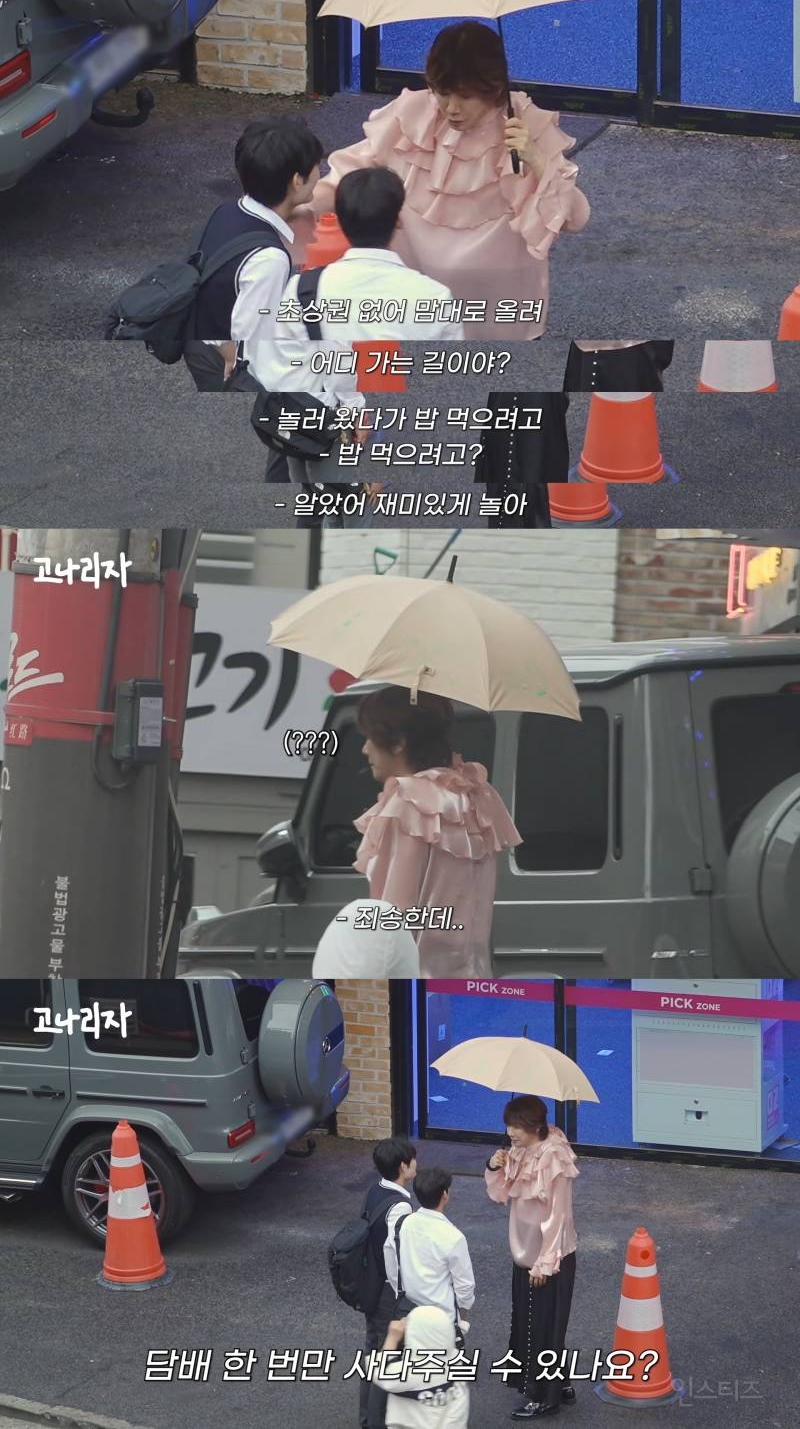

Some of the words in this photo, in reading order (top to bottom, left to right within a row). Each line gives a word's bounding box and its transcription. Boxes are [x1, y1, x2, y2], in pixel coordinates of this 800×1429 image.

[467, 980, 499, 994] PICK
[501, 987, 526, 996] ZONE
[660, 996, 693, 1009] PICK
[696, 1001, 721, 1011] ZONE
